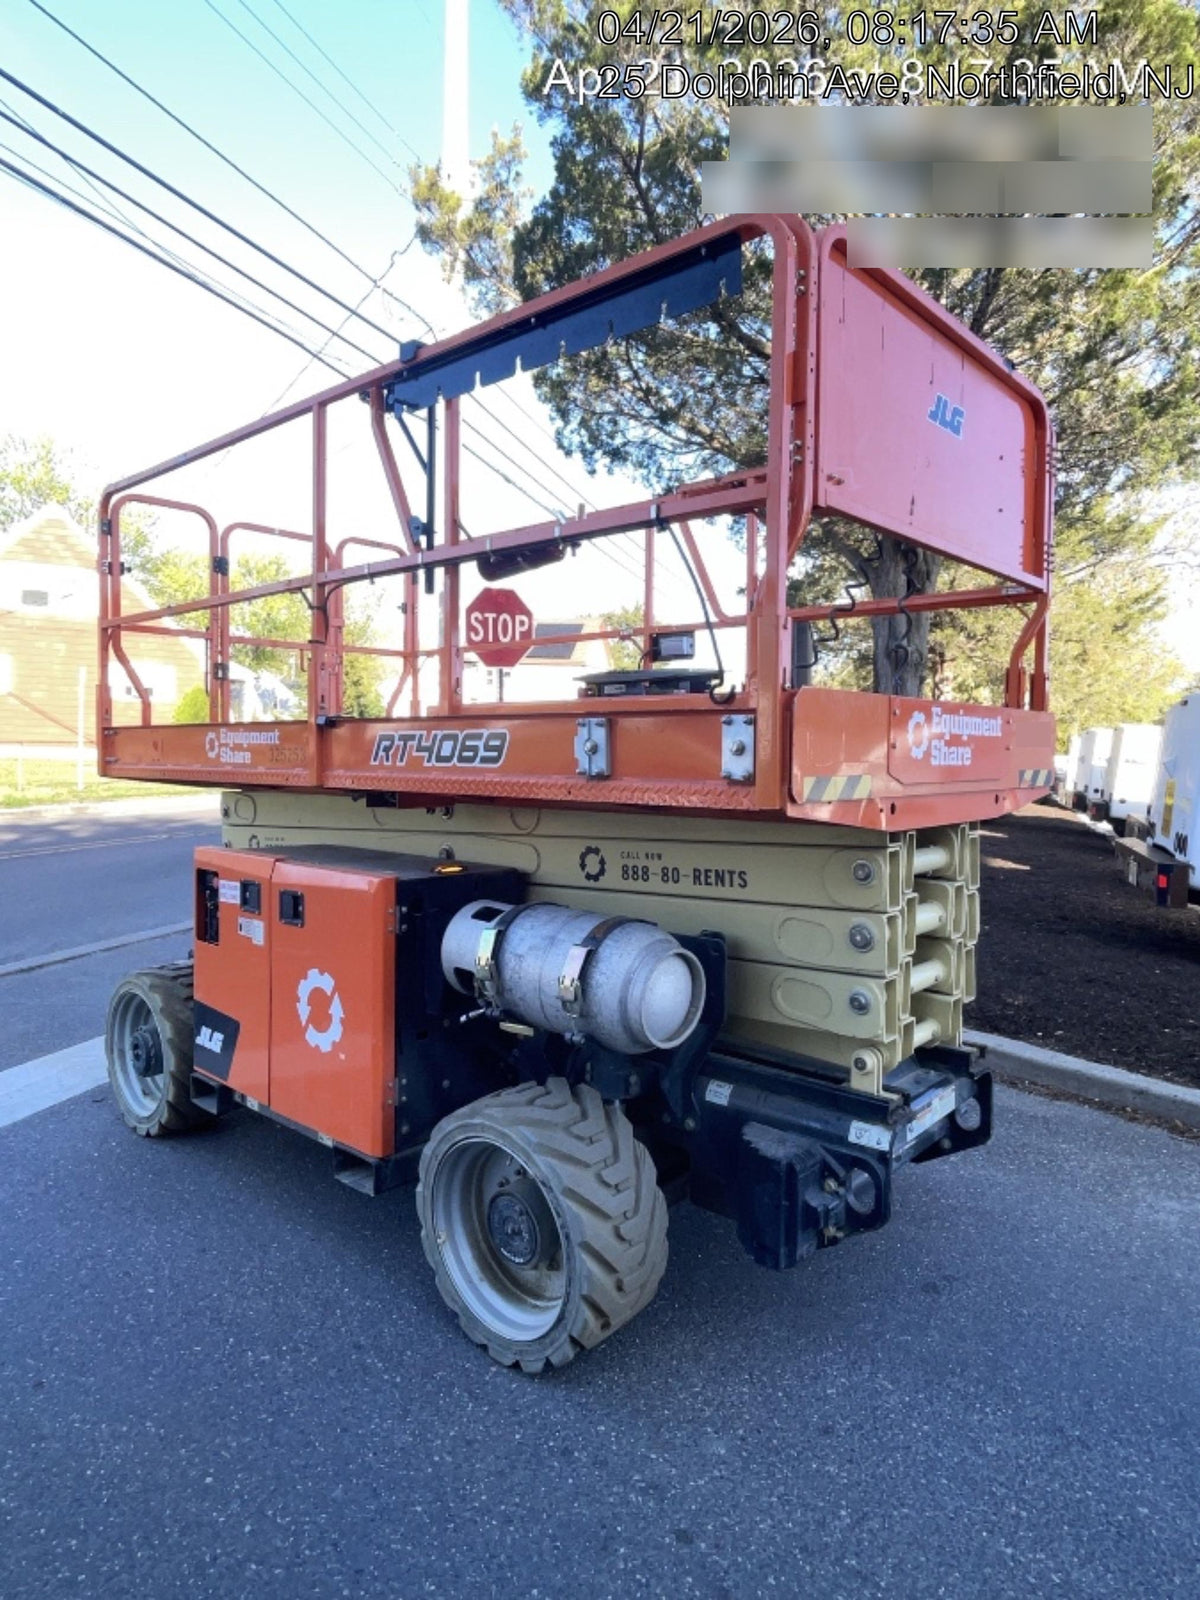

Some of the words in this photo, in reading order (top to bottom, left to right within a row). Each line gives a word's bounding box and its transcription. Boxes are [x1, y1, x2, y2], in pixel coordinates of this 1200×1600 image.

[927, 392, 966, 439] JLG
[469, 611, 529, 643] STOP
[931, 706, 1003, 741] Equipment
[220, 728, 280, 748] Equipment
[370, 729, 509, 767] RT4069
[930, 738, 973, 766] Share
[220, 747, 252, 763] Share
[620, 851, 641, 861] CALL
[621, 864, 749, 889] 888-80-RENTS
[195, 1025, 224, 1053] JLG
